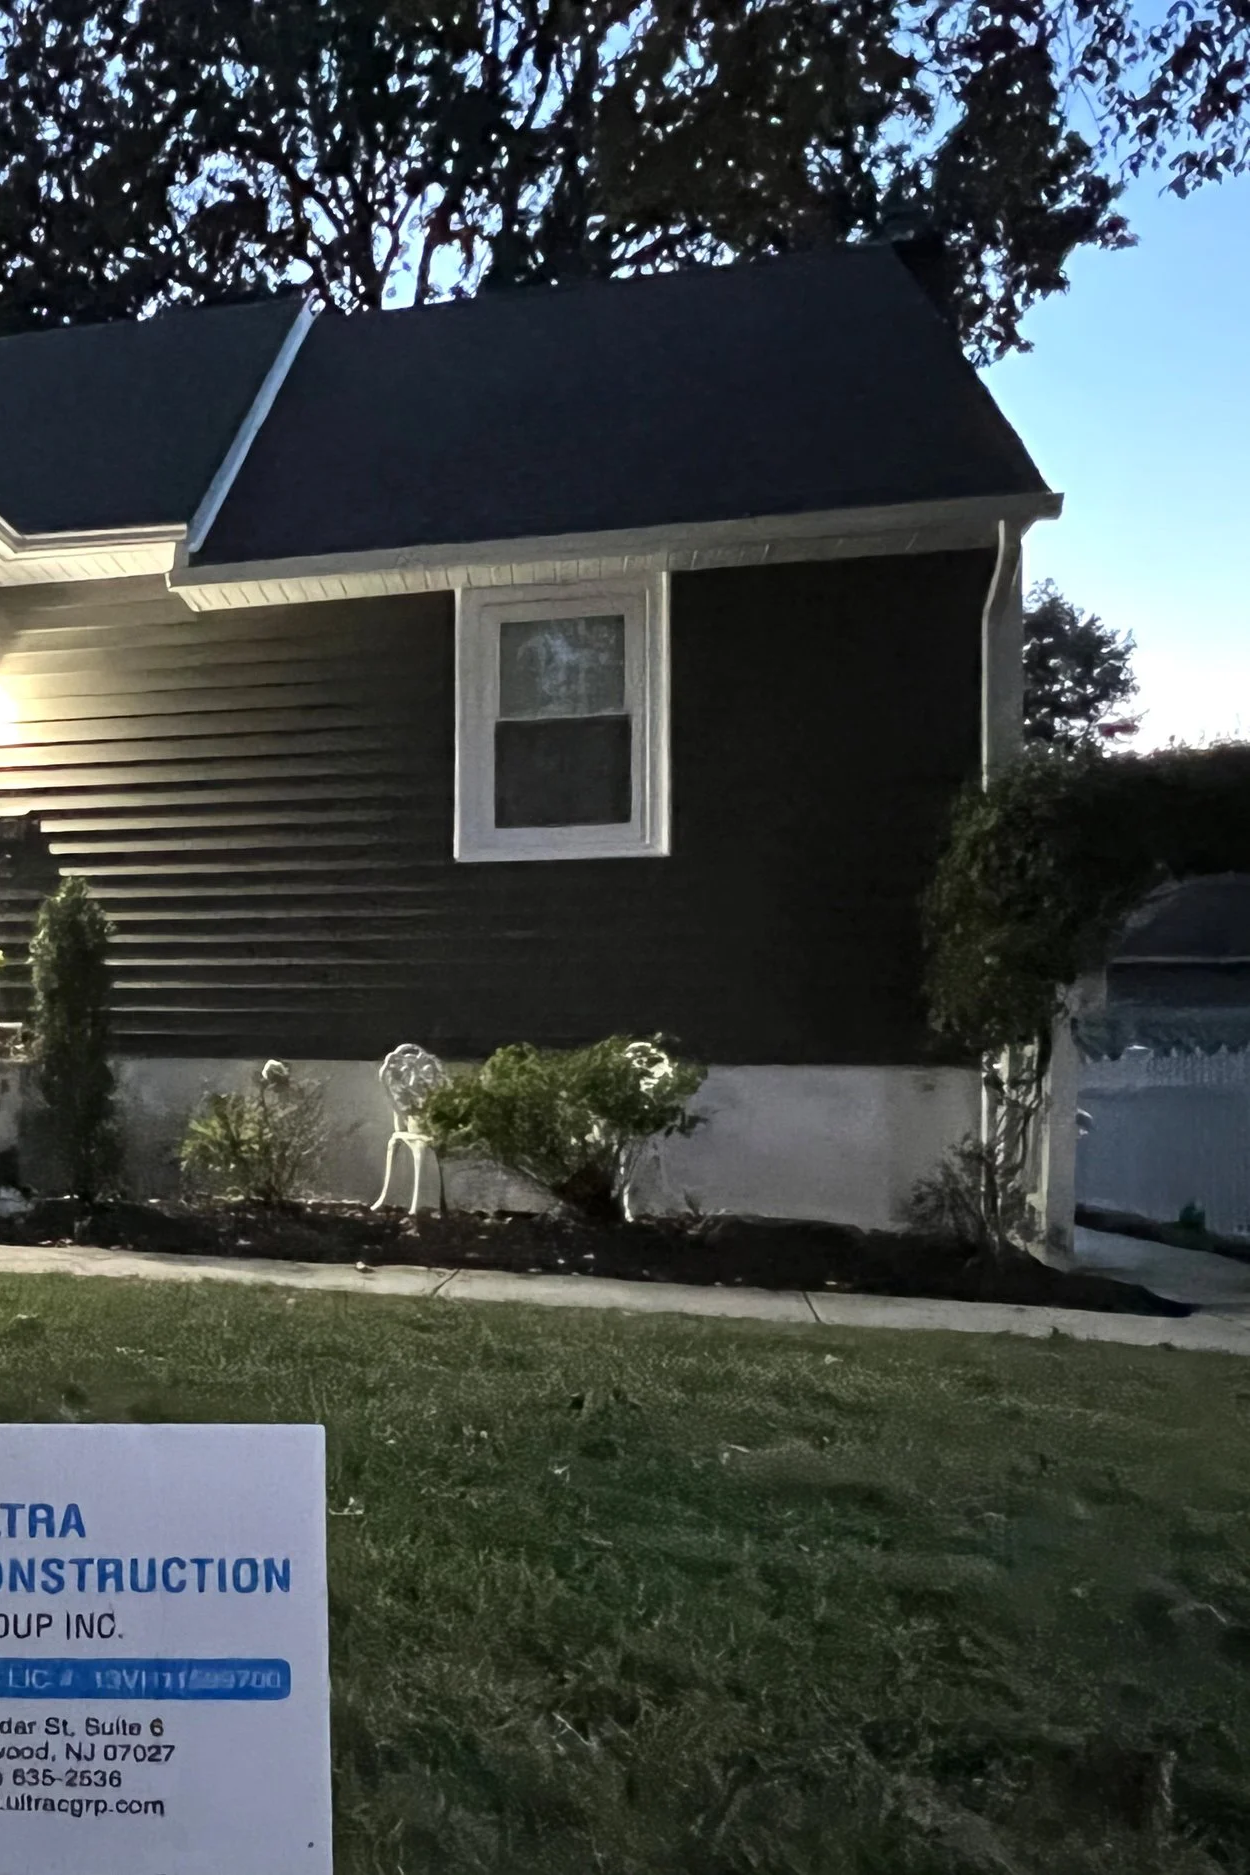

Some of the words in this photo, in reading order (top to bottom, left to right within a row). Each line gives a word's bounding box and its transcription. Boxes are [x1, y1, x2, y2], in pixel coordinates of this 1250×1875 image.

[66, 1611, 123, 1640] INC.
[85, 1716, 141, 1737] Suite
[150, 1718, 164, 1736] 6
[66, 1742, 95, 1761] NJ
[104, 1744, 175, 1762] 07027
